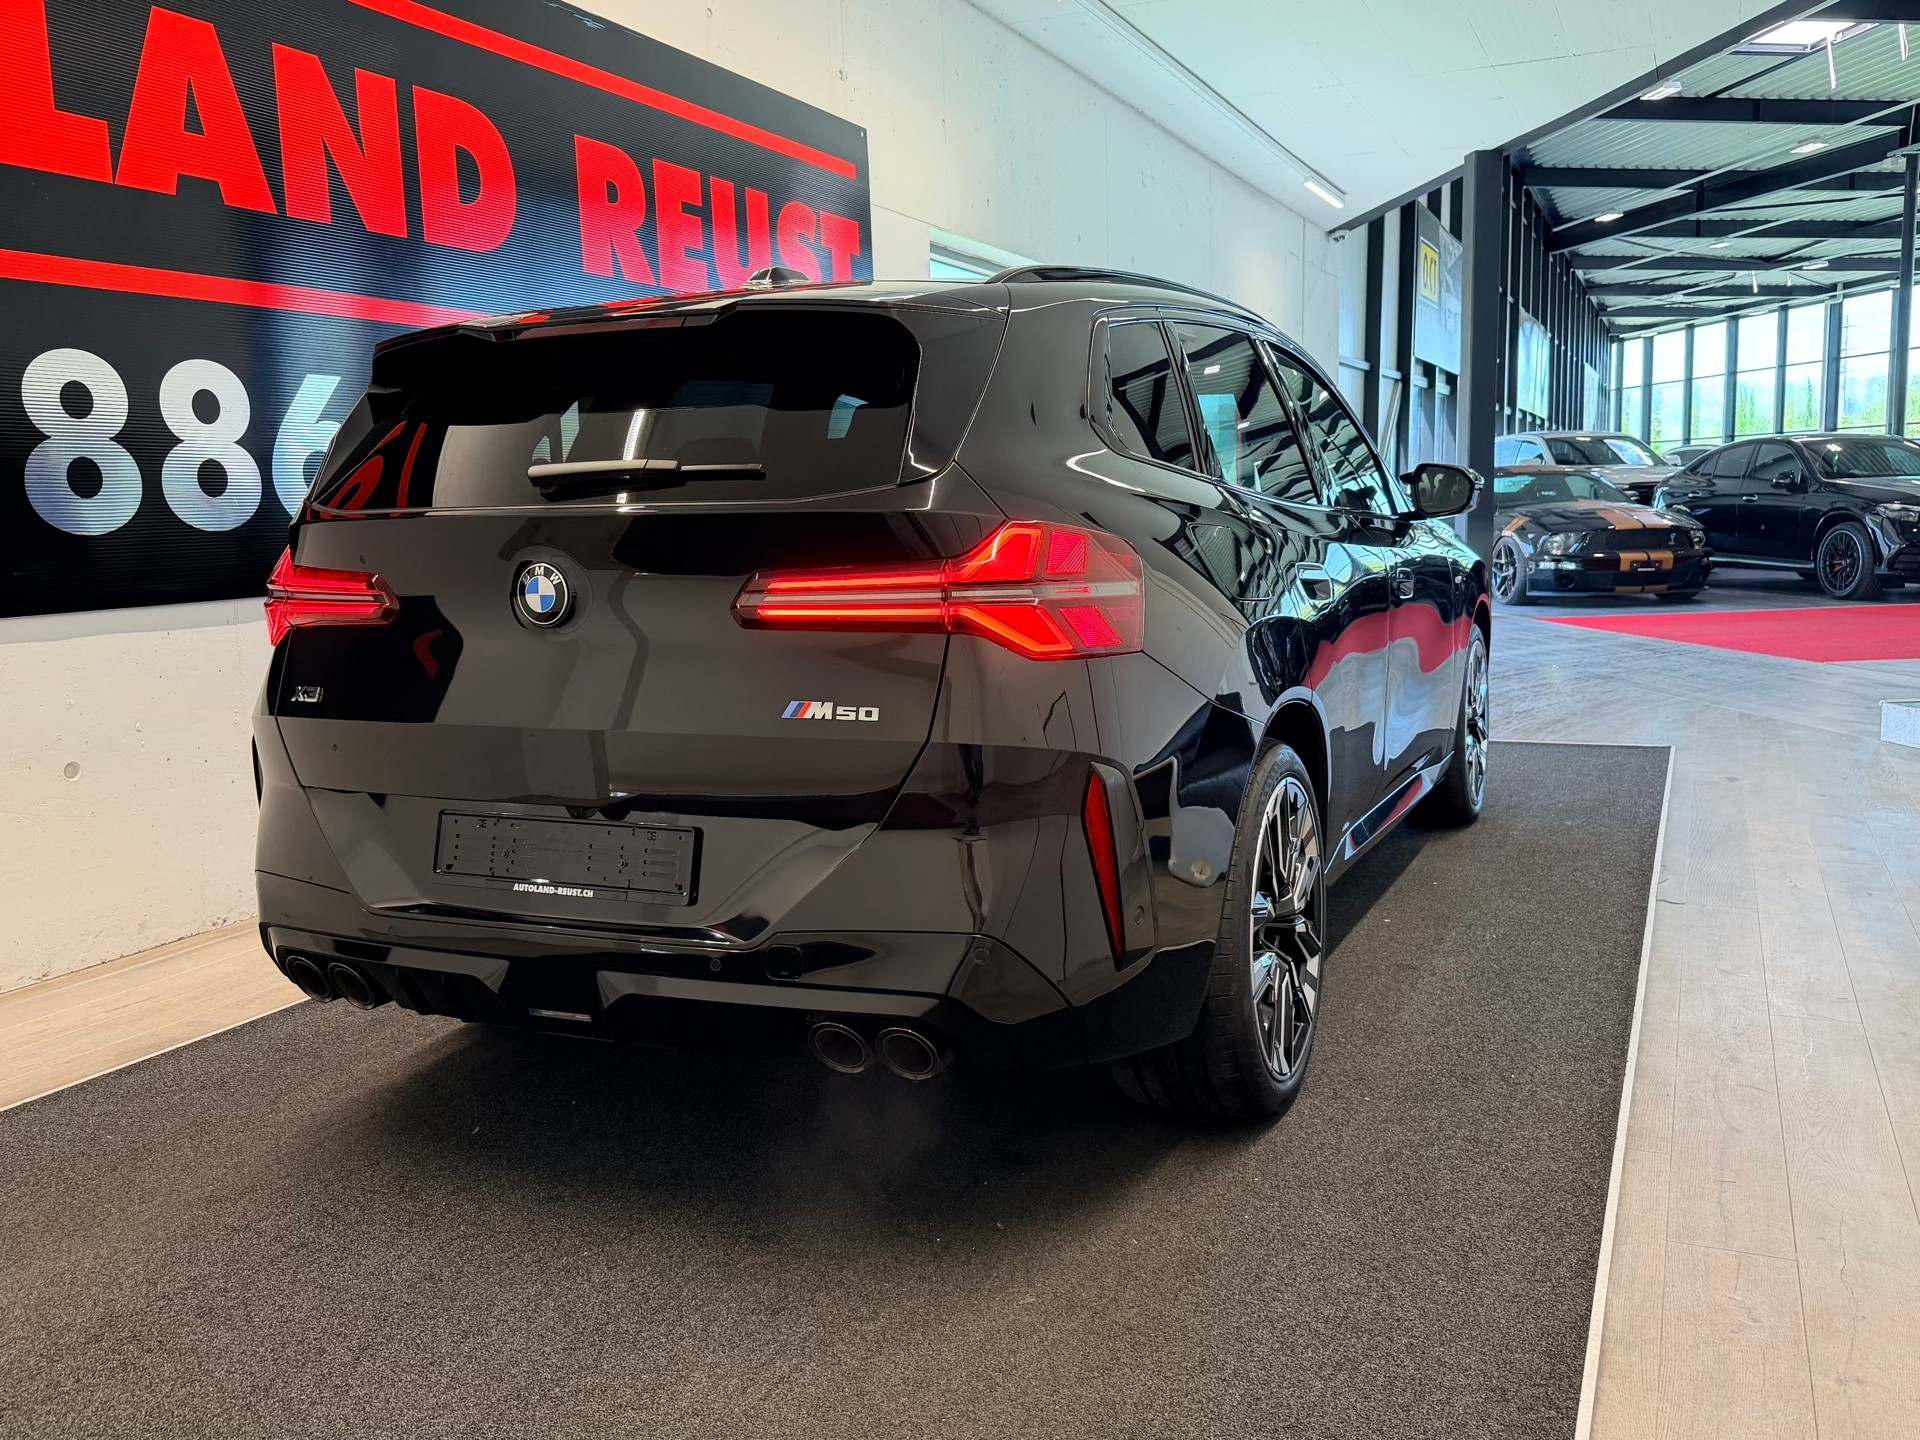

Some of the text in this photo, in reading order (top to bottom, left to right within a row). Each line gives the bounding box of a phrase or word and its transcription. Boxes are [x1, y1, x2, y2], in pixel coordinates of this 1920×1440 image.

[574, 134, 861, 294] REUST
[522, 566, 562, 586] BMW
[803, 701, 880, 721] M50
[512, 882, 594, 898] AUTOLAND-REUST.CH
